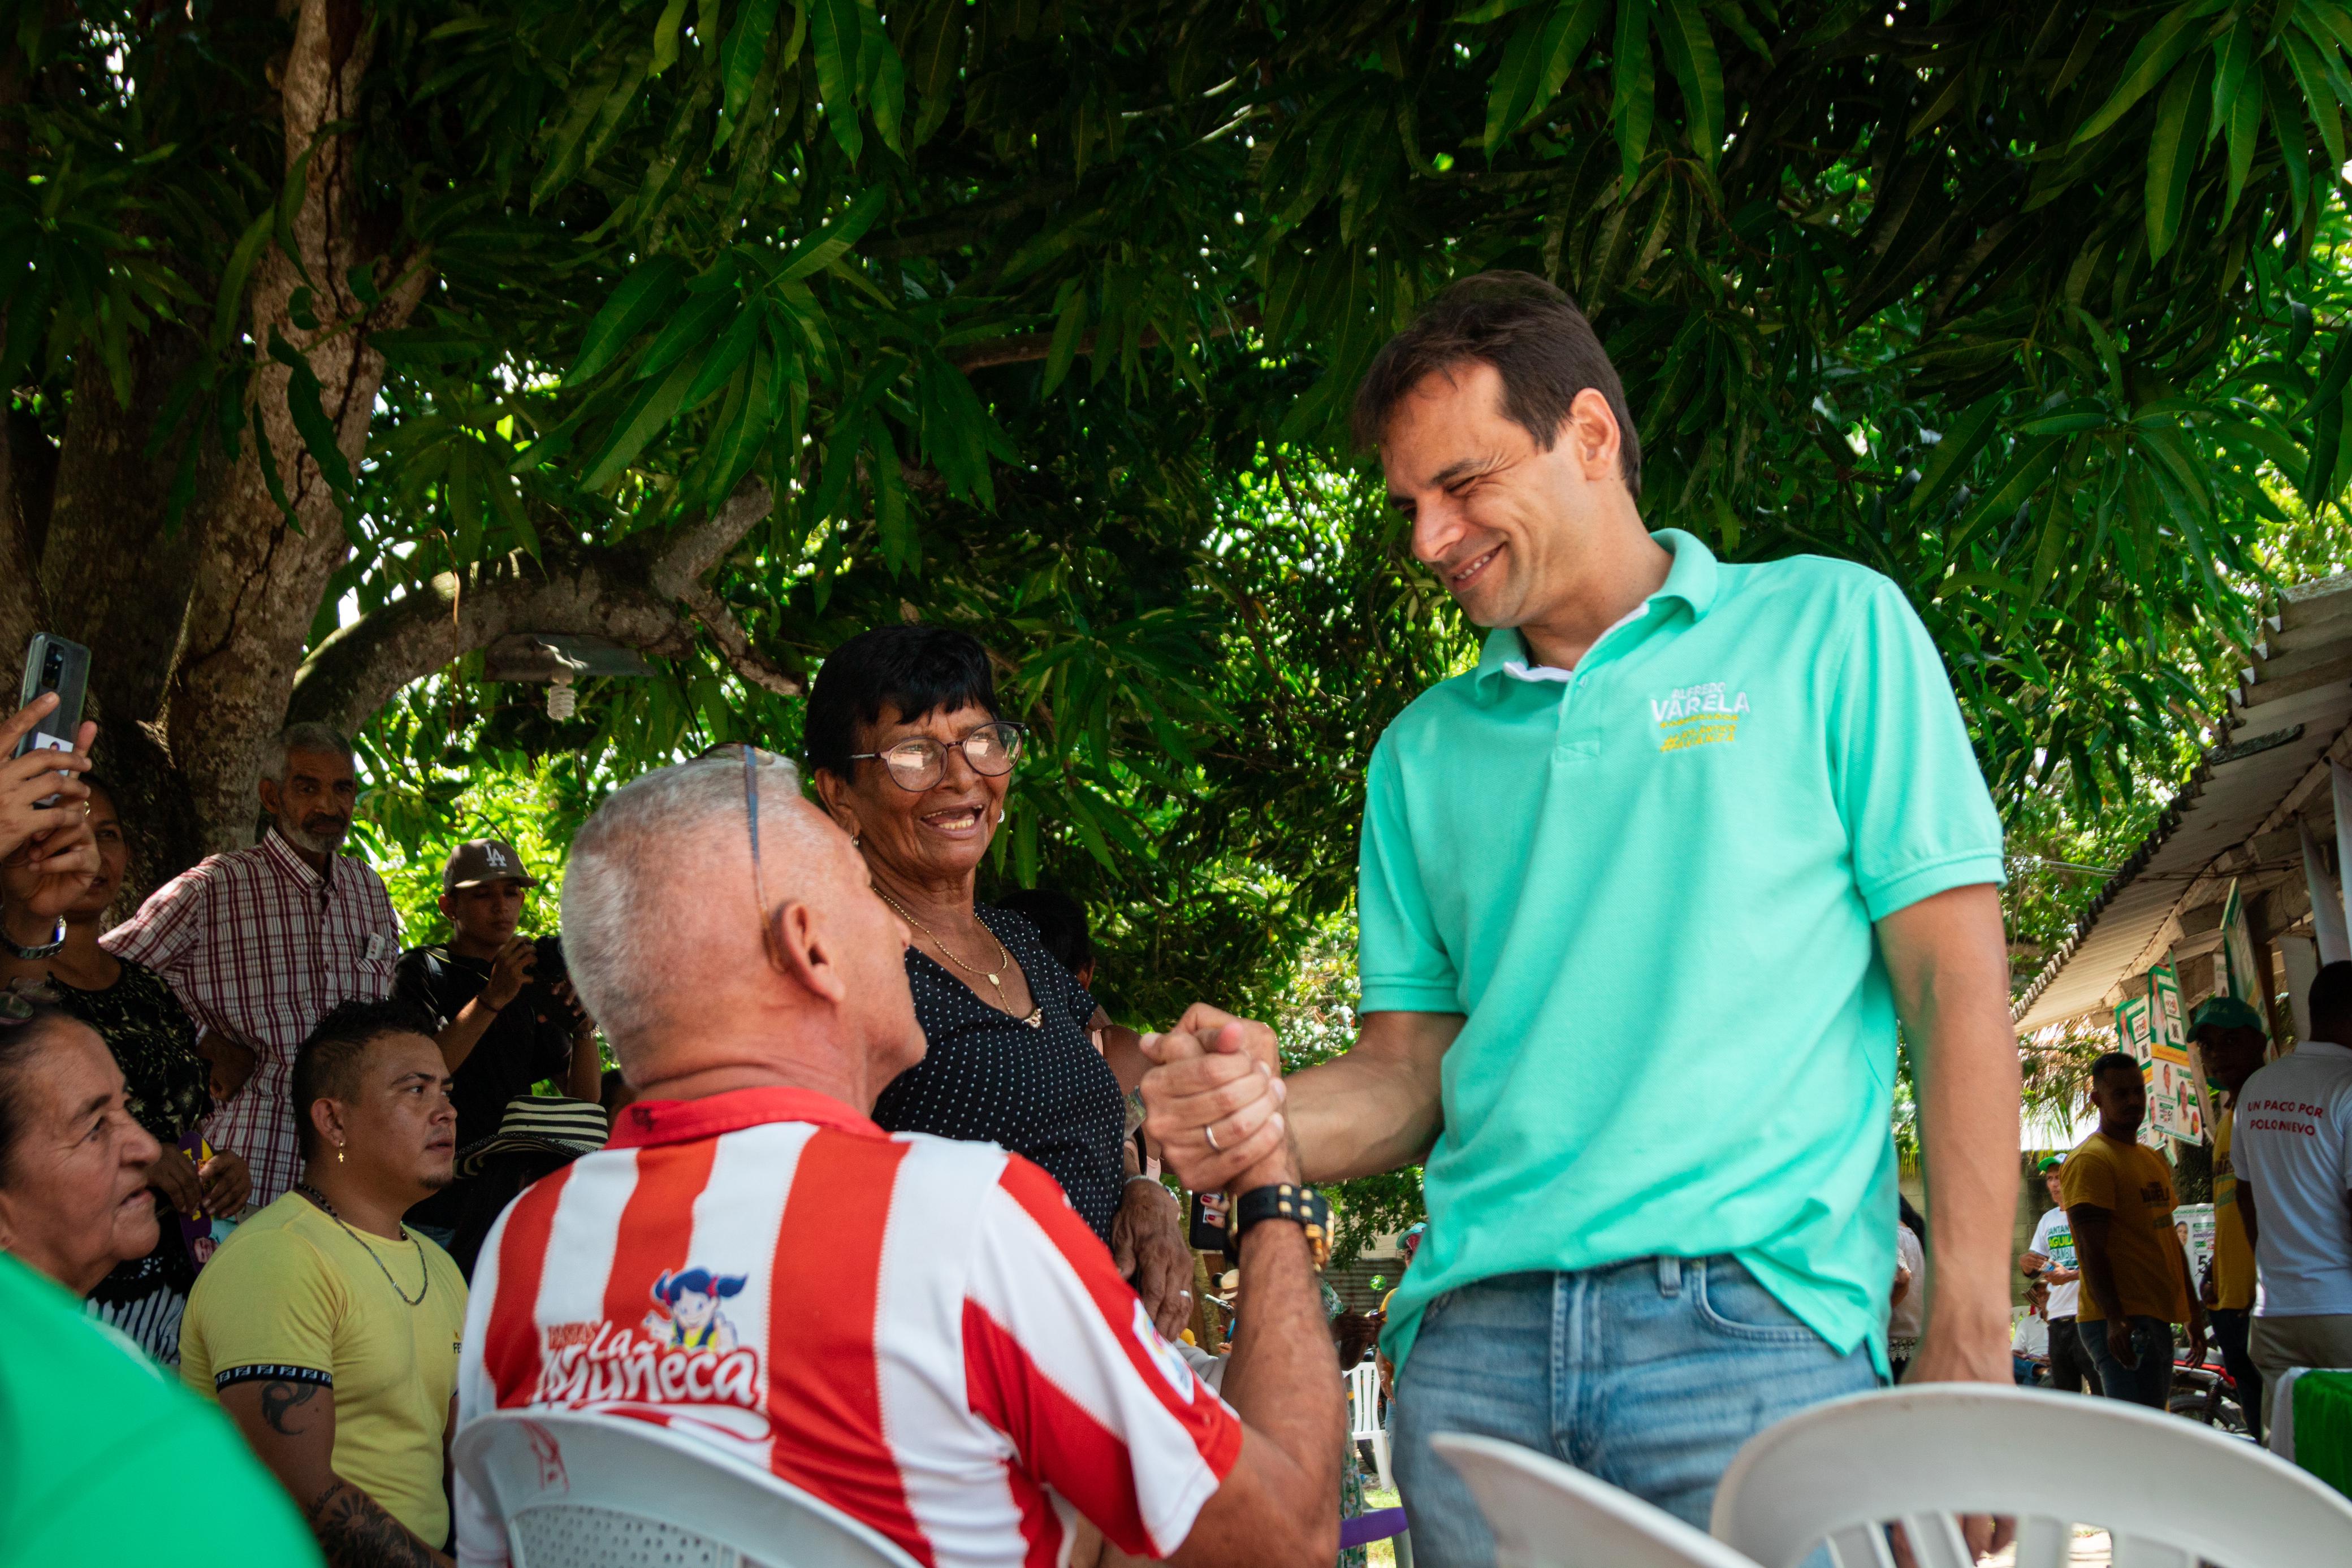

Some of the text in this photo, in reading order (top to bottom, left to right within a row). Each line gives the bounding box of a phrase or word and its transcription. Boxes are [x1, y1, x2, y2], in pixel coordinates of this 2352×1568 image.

[1671, 681, 1726, 700] ALFREDO
[1650, 691, 1750, 722] VARELA
[483, 842, 507, 867] LA
[2247, 1099, 2324, 1118] UN PACO POR
[453, 1342, 462, 1354] FE
[589, 1320, 632, 1360] La
[530, 1340, 756, 1406] Muñeca
